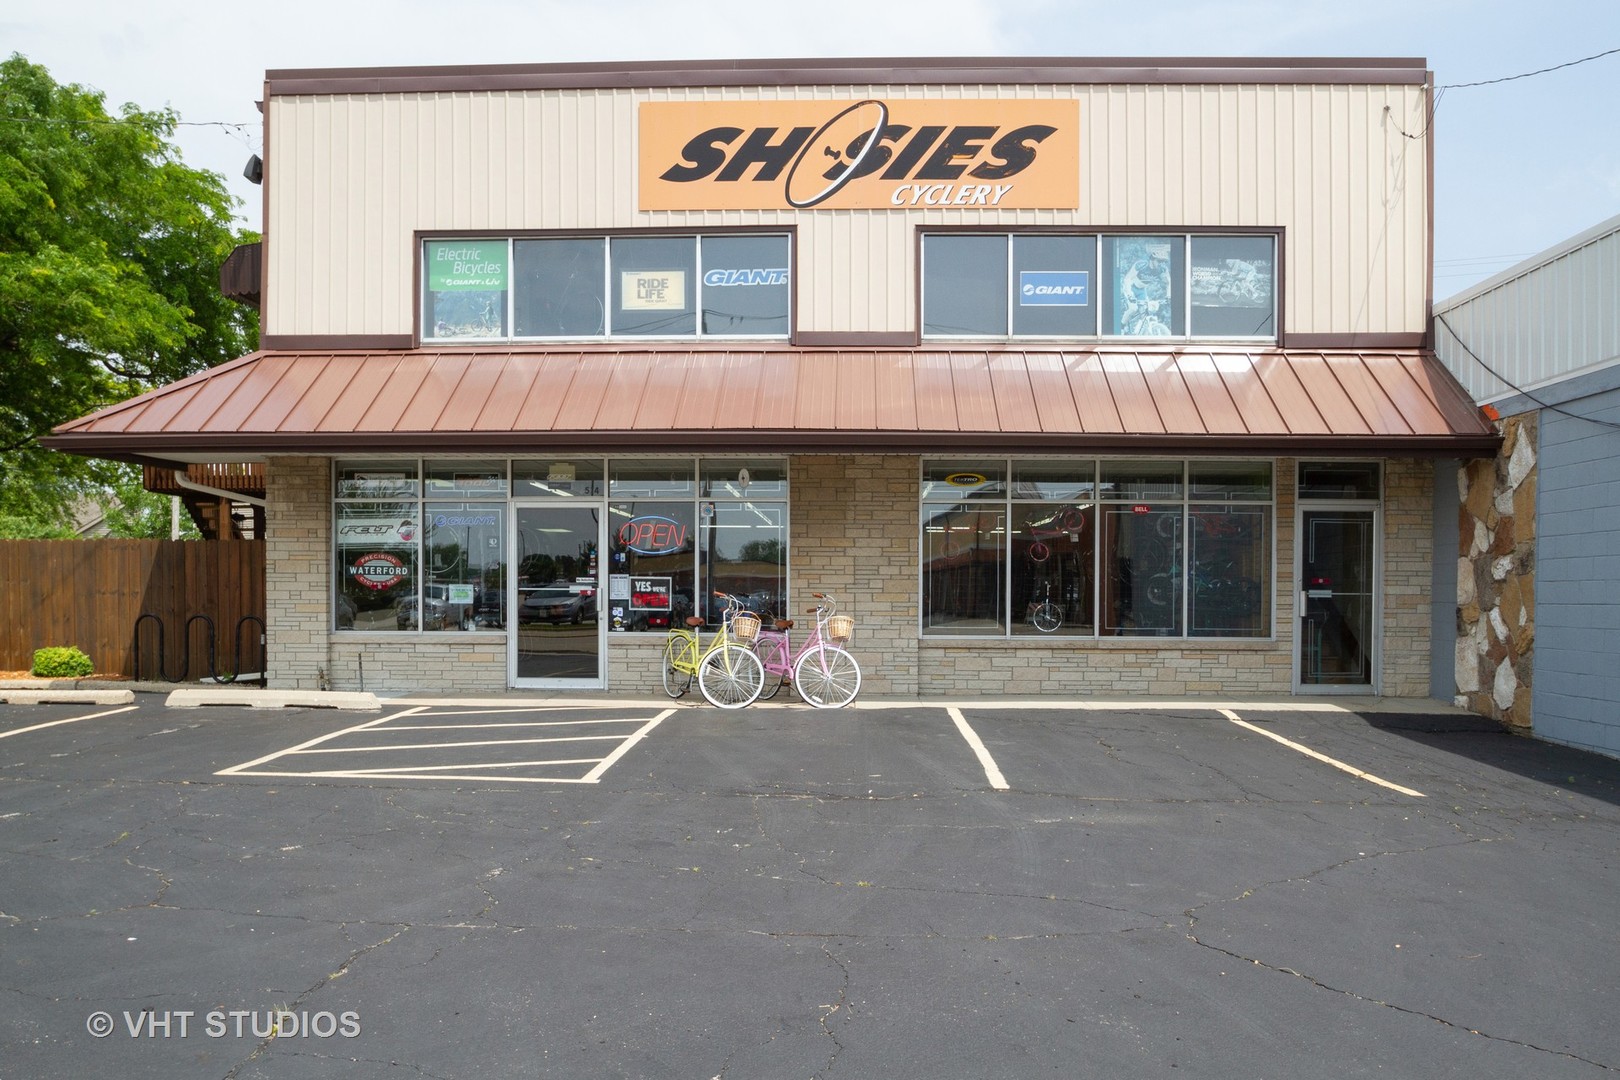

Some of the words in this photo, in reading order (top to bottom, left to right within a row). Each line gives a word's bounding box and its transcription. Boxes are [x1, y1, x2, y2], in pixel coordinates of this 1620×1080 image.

[890, 184, 1013, 206] CYCLERY
[437, 247, 481, 261] Electric
[453, 261, 502, 277] Bicycles
[704, 268, 788, 287] GIANT
[637, 278, 669, 289] RIDE
[637, 289, 665, 300] LIFE
[1035, 286, 1085, 295] GIANT
[447, 516, 496, 526] GIANT
[340, 524, 394, 535] FELT
[619, 522, 687, 547] OPEN
[360, 553, 397, 564] PRECISION
[350, 566, 408, 575] WATERFORD
[387, 577, 398, 585] USA
[635, 581, 652, 593] YES
[632, 593, 669, 607] OPEN
